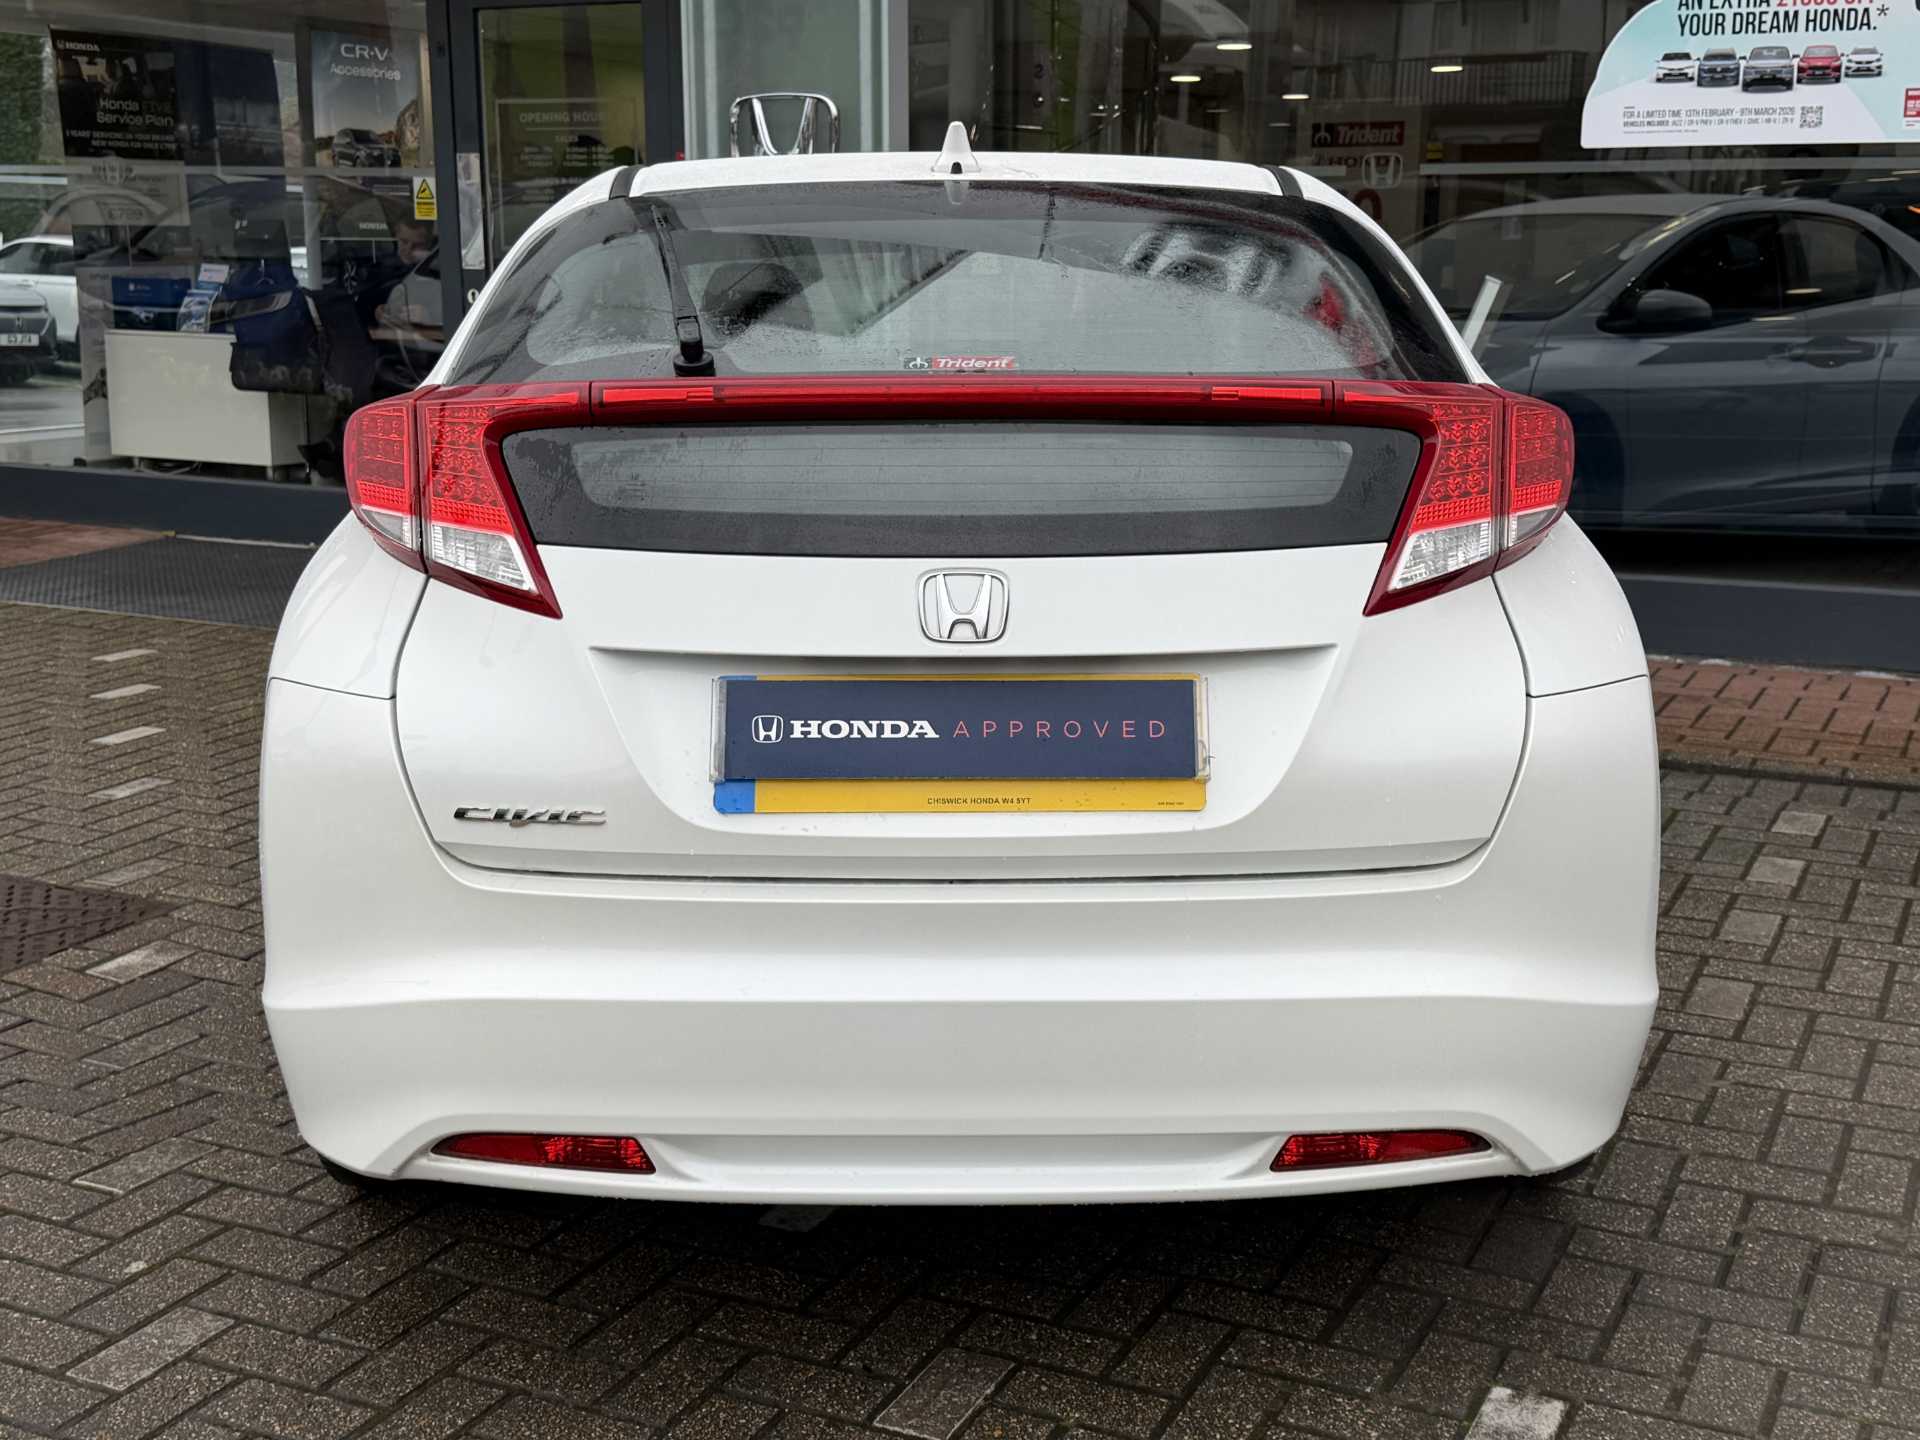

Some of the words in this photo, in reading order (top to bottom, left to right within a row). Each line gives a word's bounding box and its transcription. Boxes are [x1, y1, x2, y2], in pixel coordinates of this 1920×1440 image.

[1678, 13, 1726, 36] YOUR
[1731, 10, 1799, 35] DREAM
[66, 41, 99, 51] HONDA
[330, 63, 400, 80] Accessories
[100, 98, 139, 111] Honda
[97, 112, 143, 125] Service
[145, 114, 174, 127] Plan
[520, 112, 570, 122] OPENING
[1624, 111, 1635, 119] FOR
[1642, 109, 1666, 118] LIMITED
[1701, 108, 1734, 117] FEBRUARY
[1753, 107, 1777, 116] MARCH
[1337, 124, 1400, 145] Trident
[937, 358, 1009, 368] Trident
[789, 720, 940, 738] HONDA
[953, 720, 1165, 738] APPROVED
[928, 797, 968, 805] CHISWICK
[970, 797, 1000, 805] HONDA
